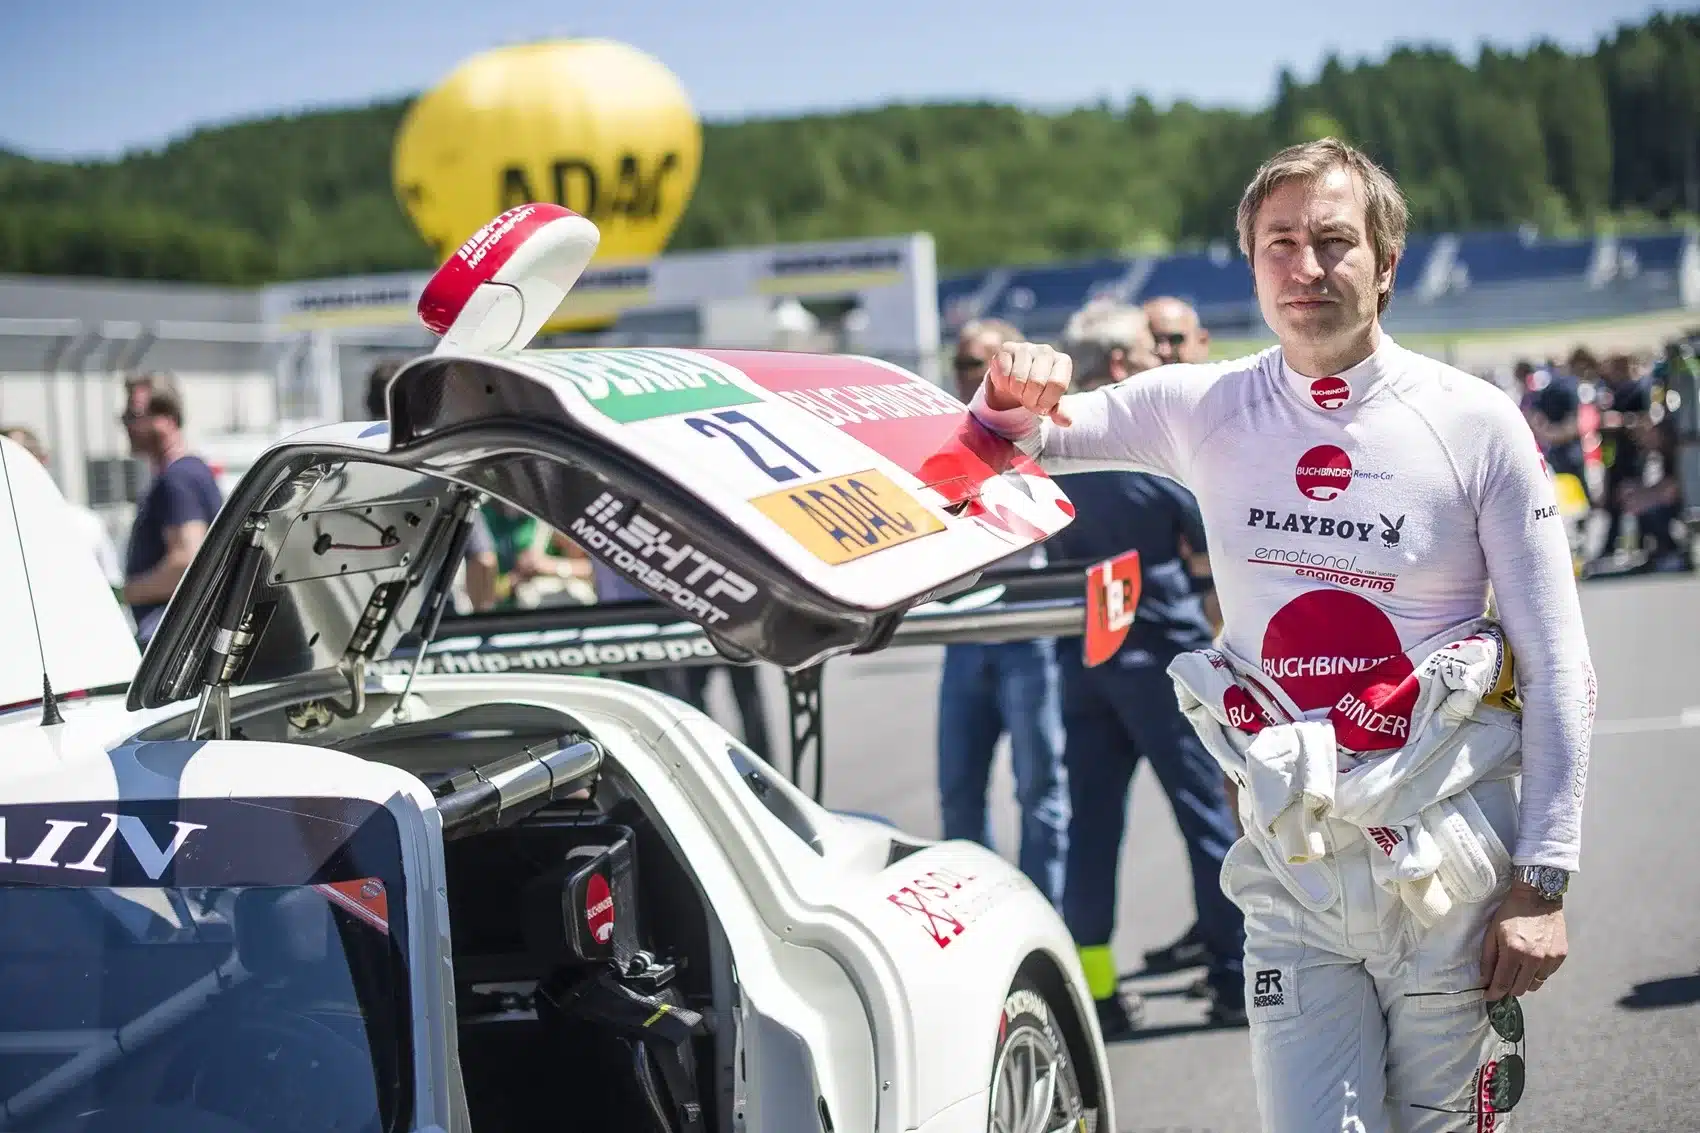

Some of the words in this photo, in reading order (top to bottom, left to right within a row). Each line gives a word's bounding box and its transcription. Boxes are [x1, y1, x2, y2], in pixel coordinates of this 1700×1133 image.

[467, 207, 536, 269] MOTORSPORT
[776, 383, 965, 425] BUCHBINDER
[1311, 385, 1350, 396] BUCHBINDER
[684, 411, 822, 482] 27
[1296, 466, 1353, 478] BUCHBINDER
[1353, 469, 1394, 481] Rent-a-Car
[788, 479, 916, 552] ADAC
[1247, 508, 1375, 542] PLAYBOY
[571, 517, 730, 624] MOTORSPORT
[1254, 547, 1357, 570] emotional
[1295, 568, 1395, 593] engineering
[1335, 692, 1408, 738] BINDER
